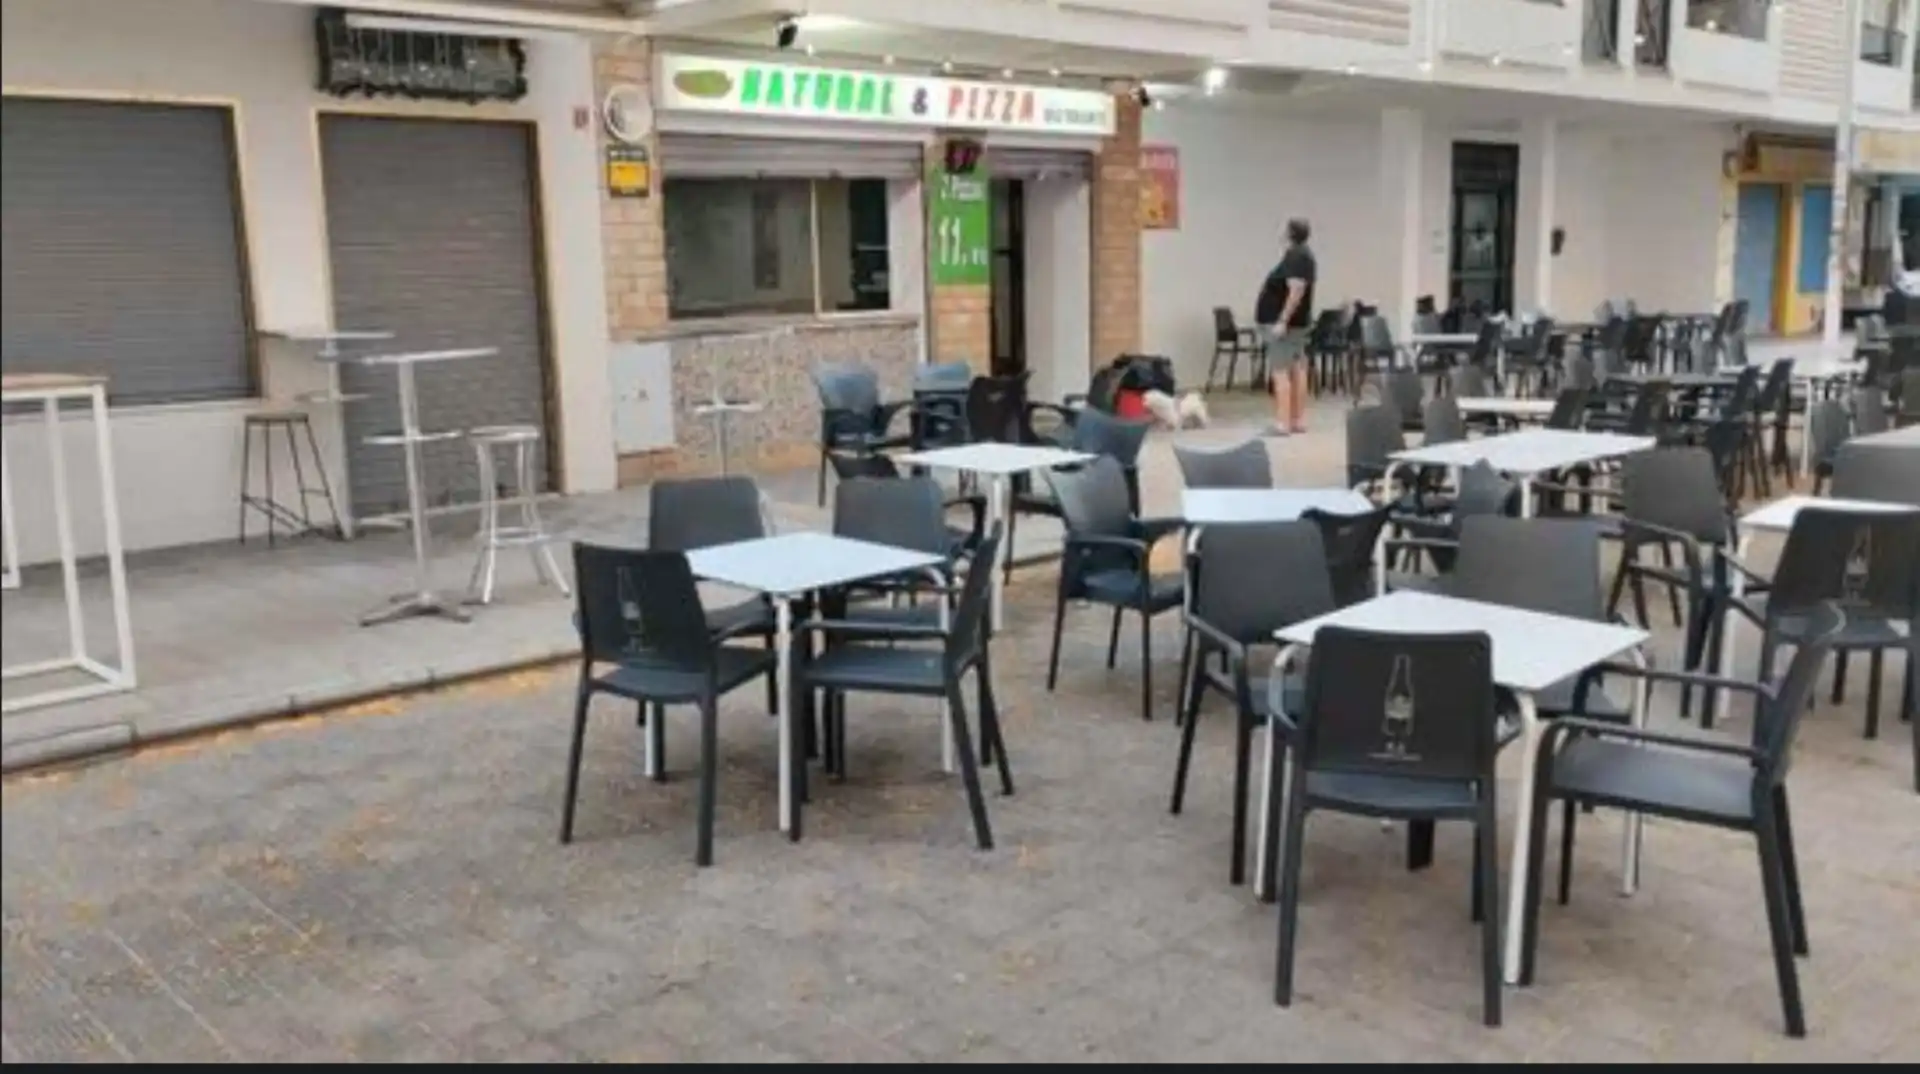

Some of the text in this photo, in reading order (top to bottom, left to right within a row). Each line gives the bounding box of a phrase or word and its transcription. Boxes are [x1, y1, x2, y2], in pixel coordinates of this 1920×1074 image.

[740, 69, 894, 115] NATURAL
[911, 87, 928, 115] &
[947, 87, 1034, 122] PIZZA
